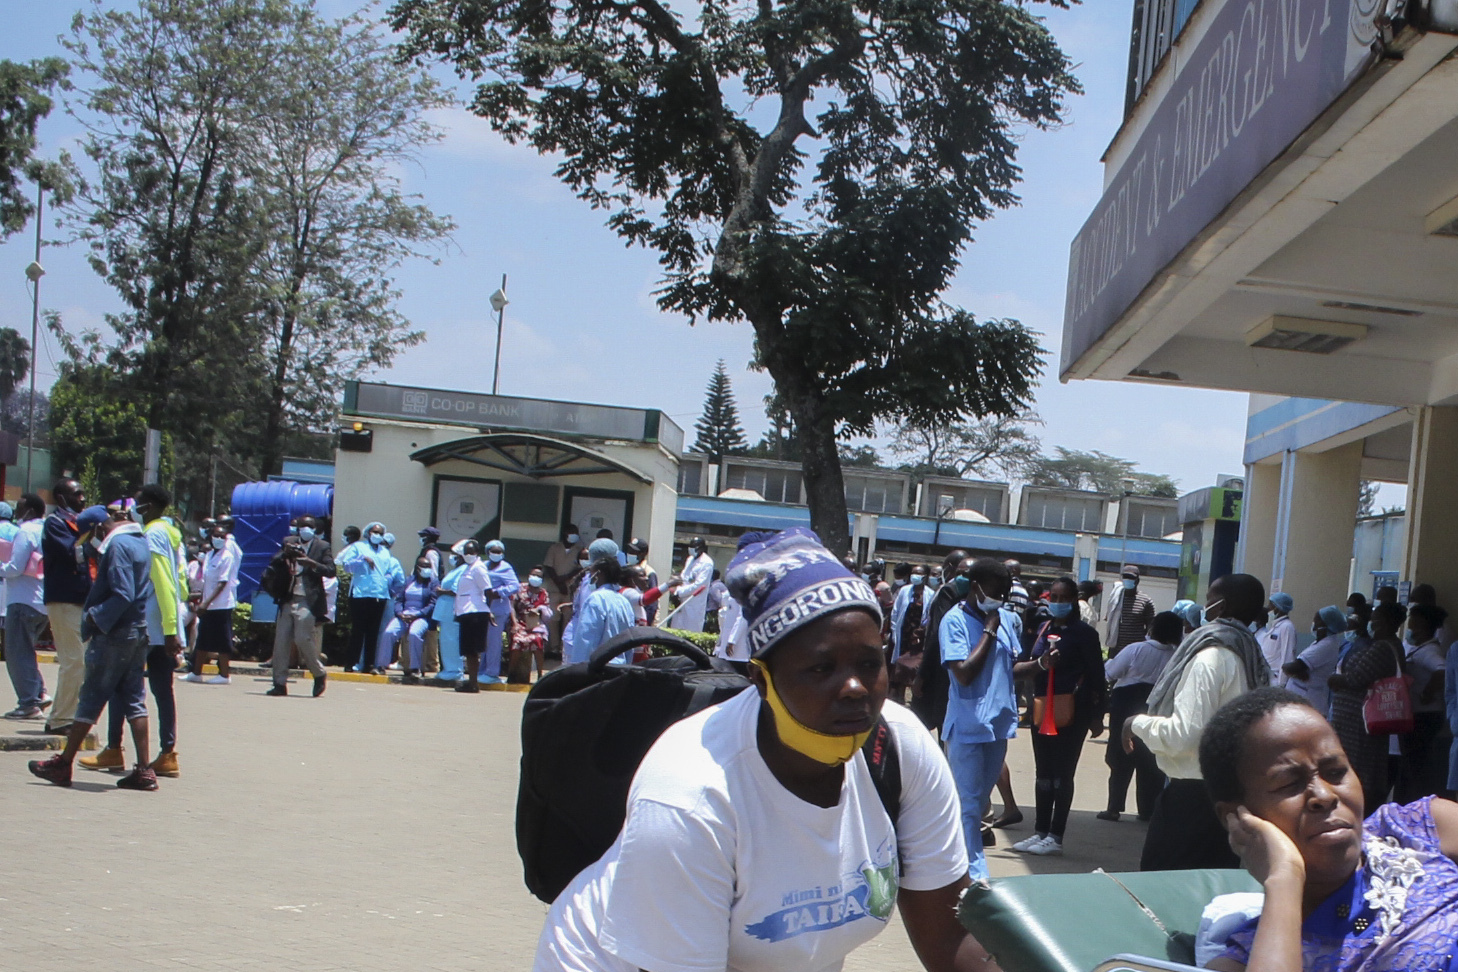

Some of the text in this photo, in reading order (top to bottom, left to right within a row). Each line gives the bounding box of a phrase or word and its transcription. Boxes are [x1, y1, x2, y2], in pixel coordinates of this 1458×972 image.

[479, 402, 520, 418] BANK
[781, 886, 823, 906] Mimi
[783, 895, 865, 934] TAIFA
